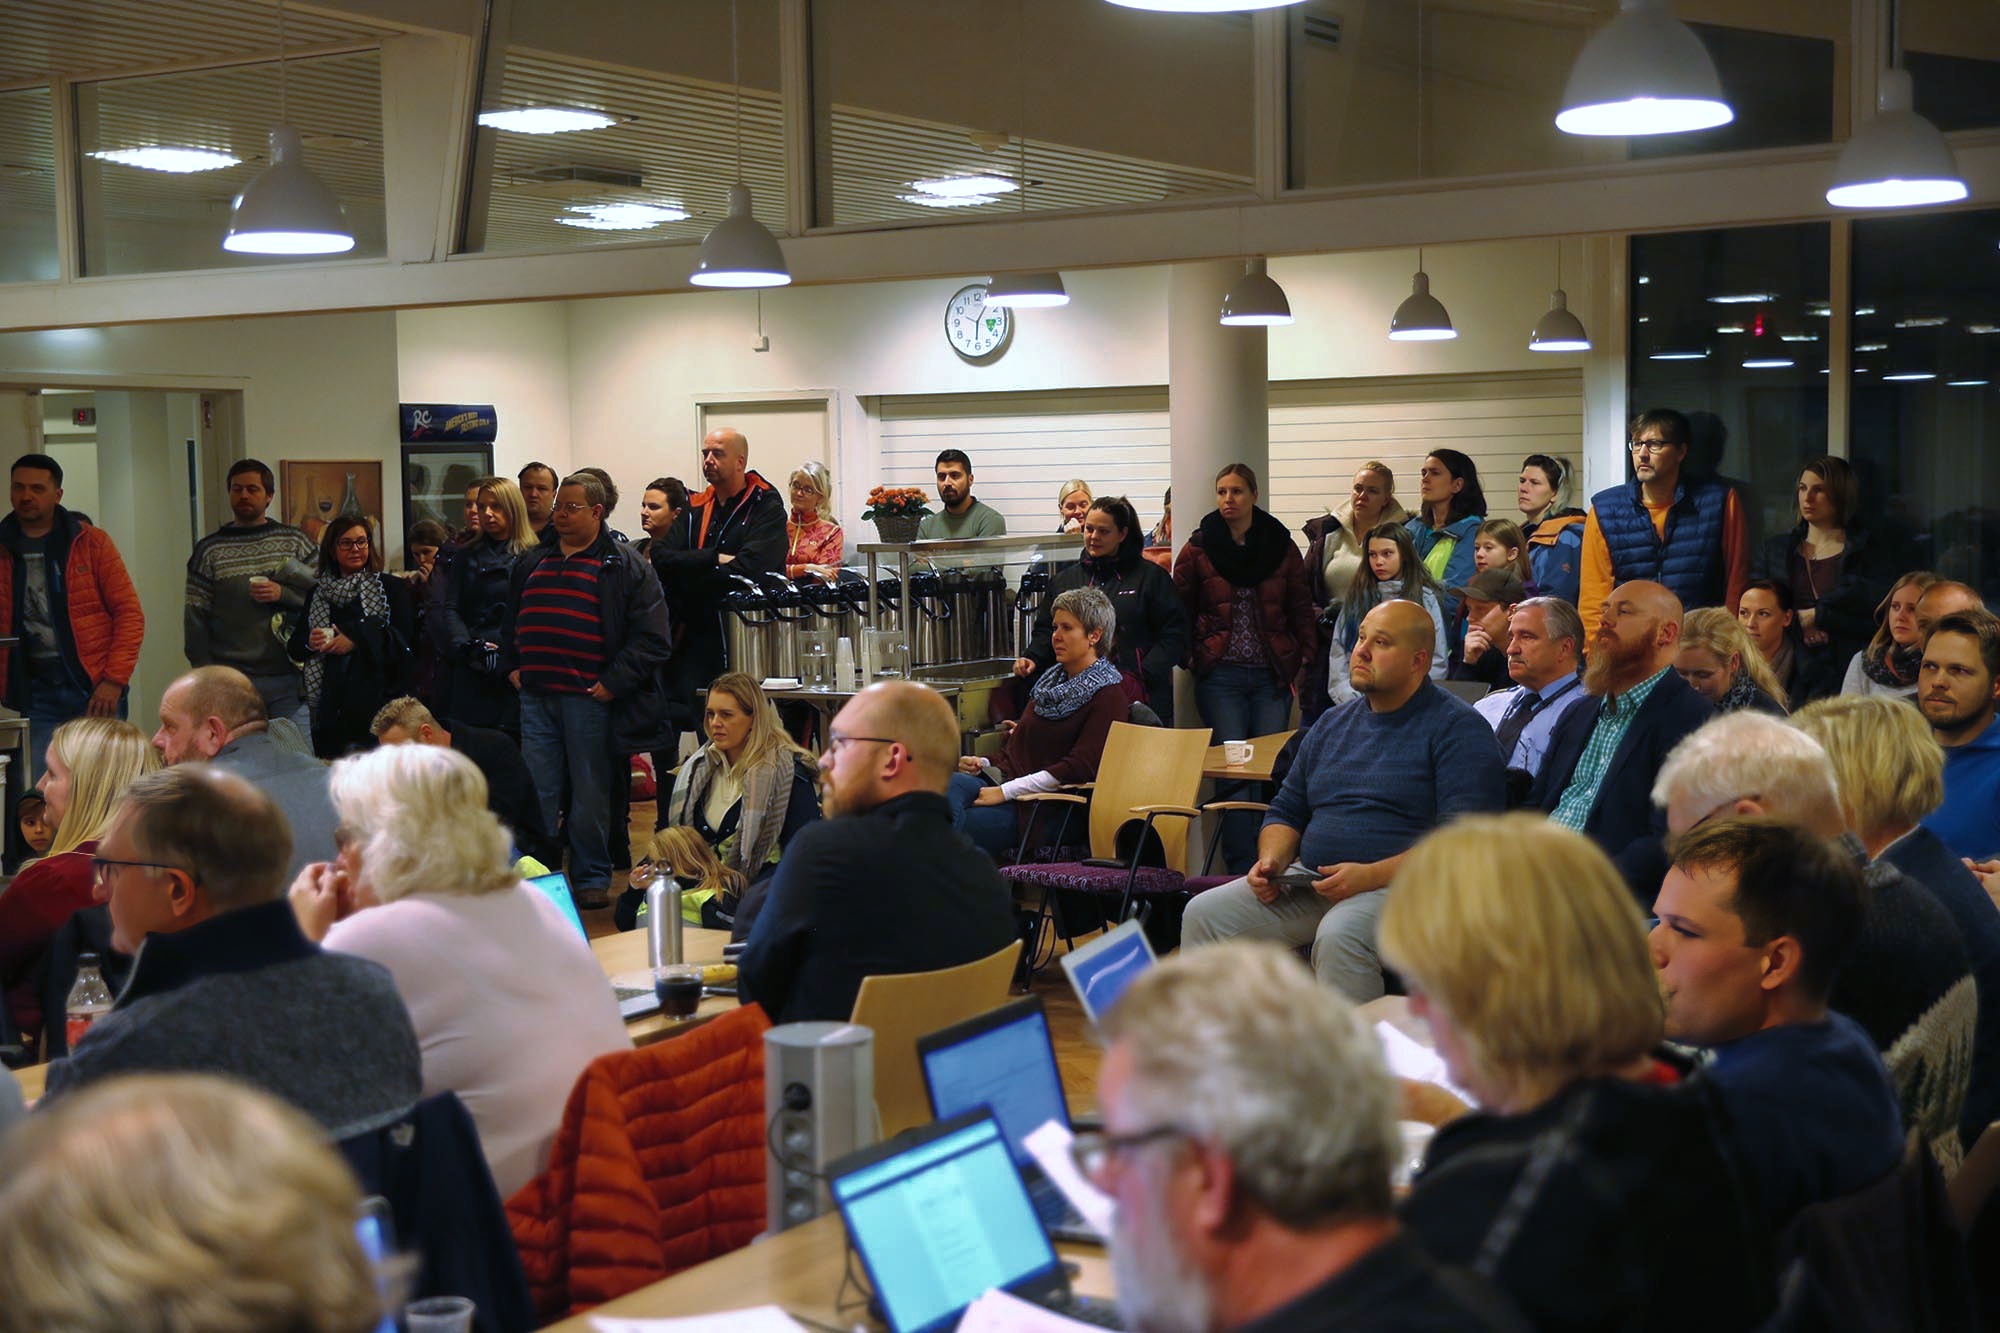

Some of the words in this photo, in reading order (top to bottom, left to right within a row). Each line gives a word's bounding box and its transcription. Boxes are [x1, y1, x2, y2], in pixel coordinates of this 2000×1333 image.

[974, 293, 981, 301] 12
[956, 306, 964, 314] 10
[954, 319, 960, 327] 9
[957, 330, 963, 339] 8
[966, 340, 971, 348] 7
[985, 339, 991, 347] 5
[412, 409, 432, 430] RC
